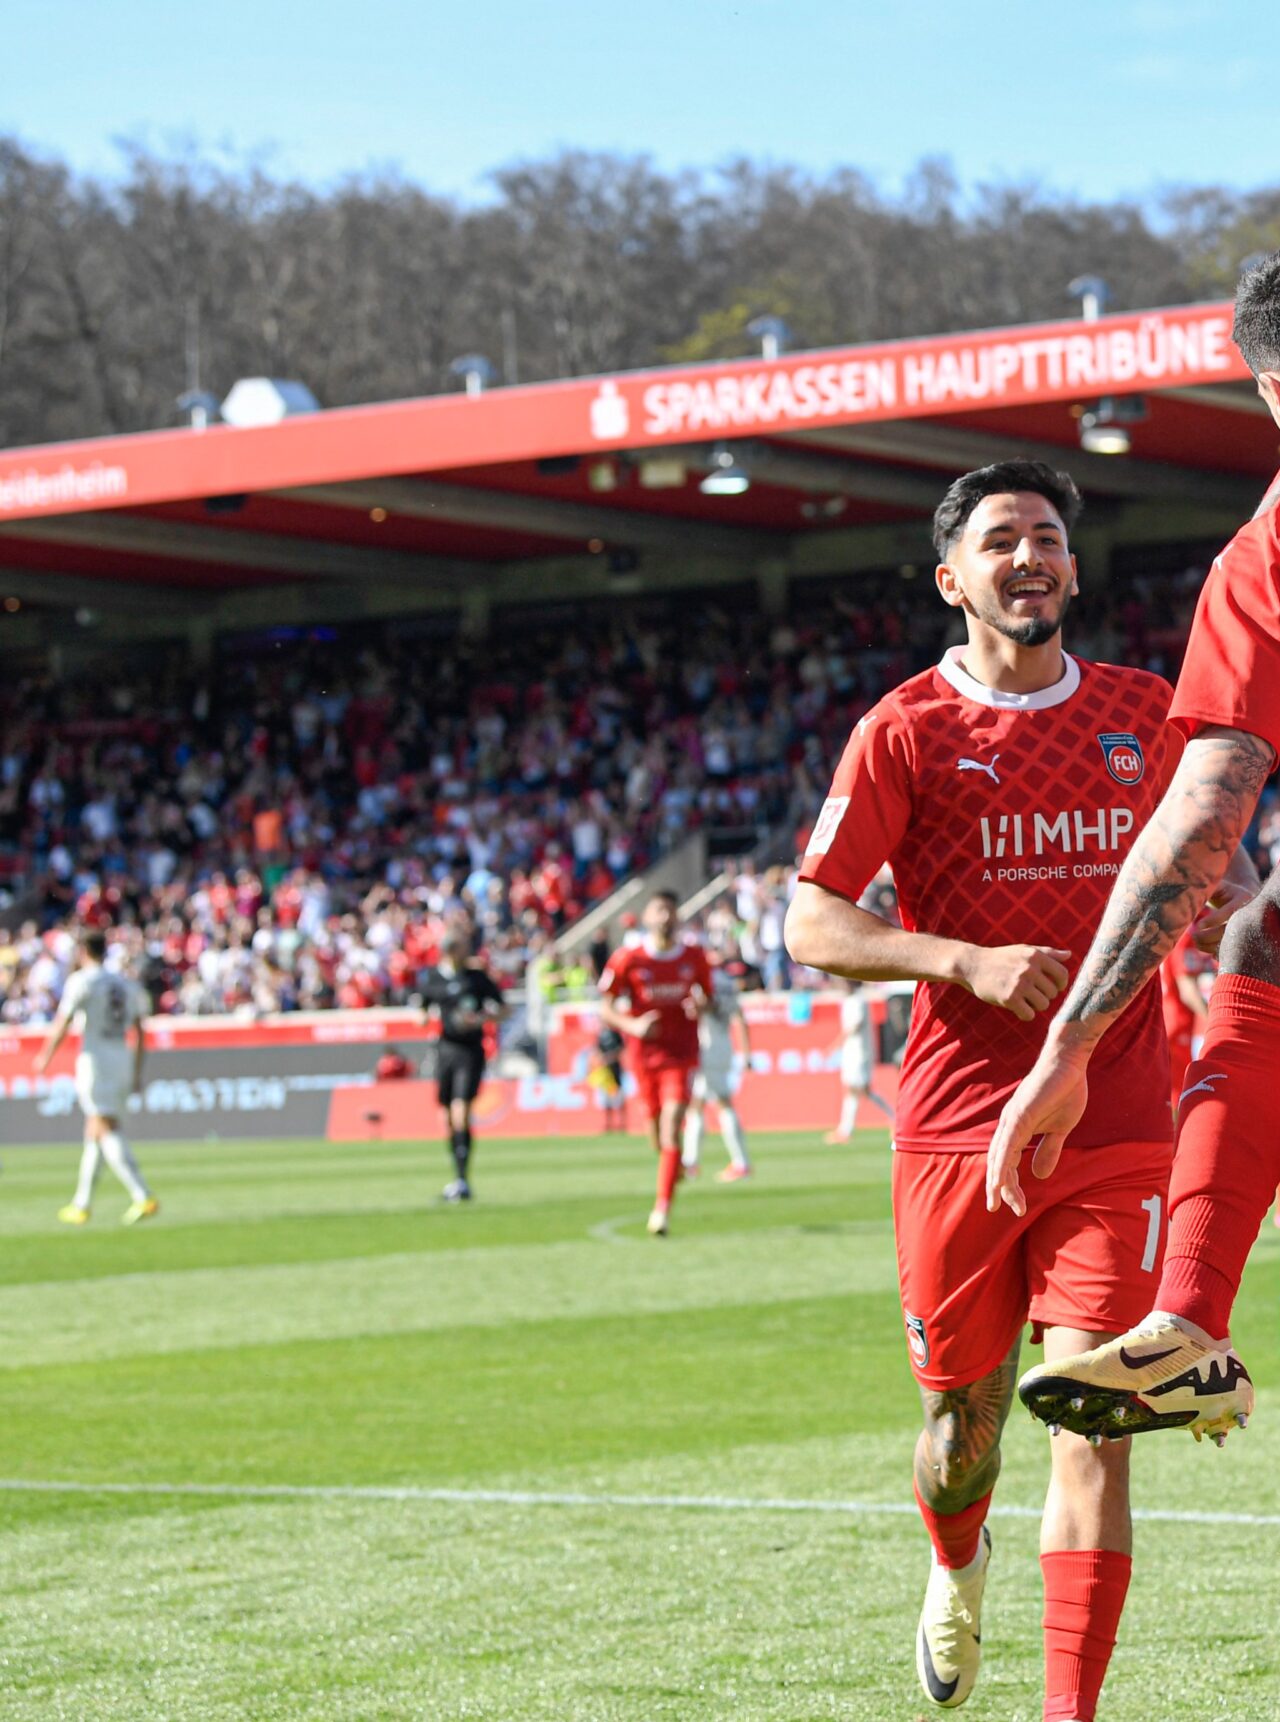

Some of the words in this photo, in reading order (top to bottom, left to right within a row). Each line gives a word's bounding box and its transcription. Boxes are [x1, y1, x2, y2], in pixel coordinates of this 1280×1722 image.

[643, 359, 896, 435] SPARKASSEN
[903, 316, 1230, 405] HAUPTTRIBÜNE
[1113, 755, 1138, 771] FCH
[982, 869, 993, 882] A
[997, 865, 1067, 881] PORSCHE
